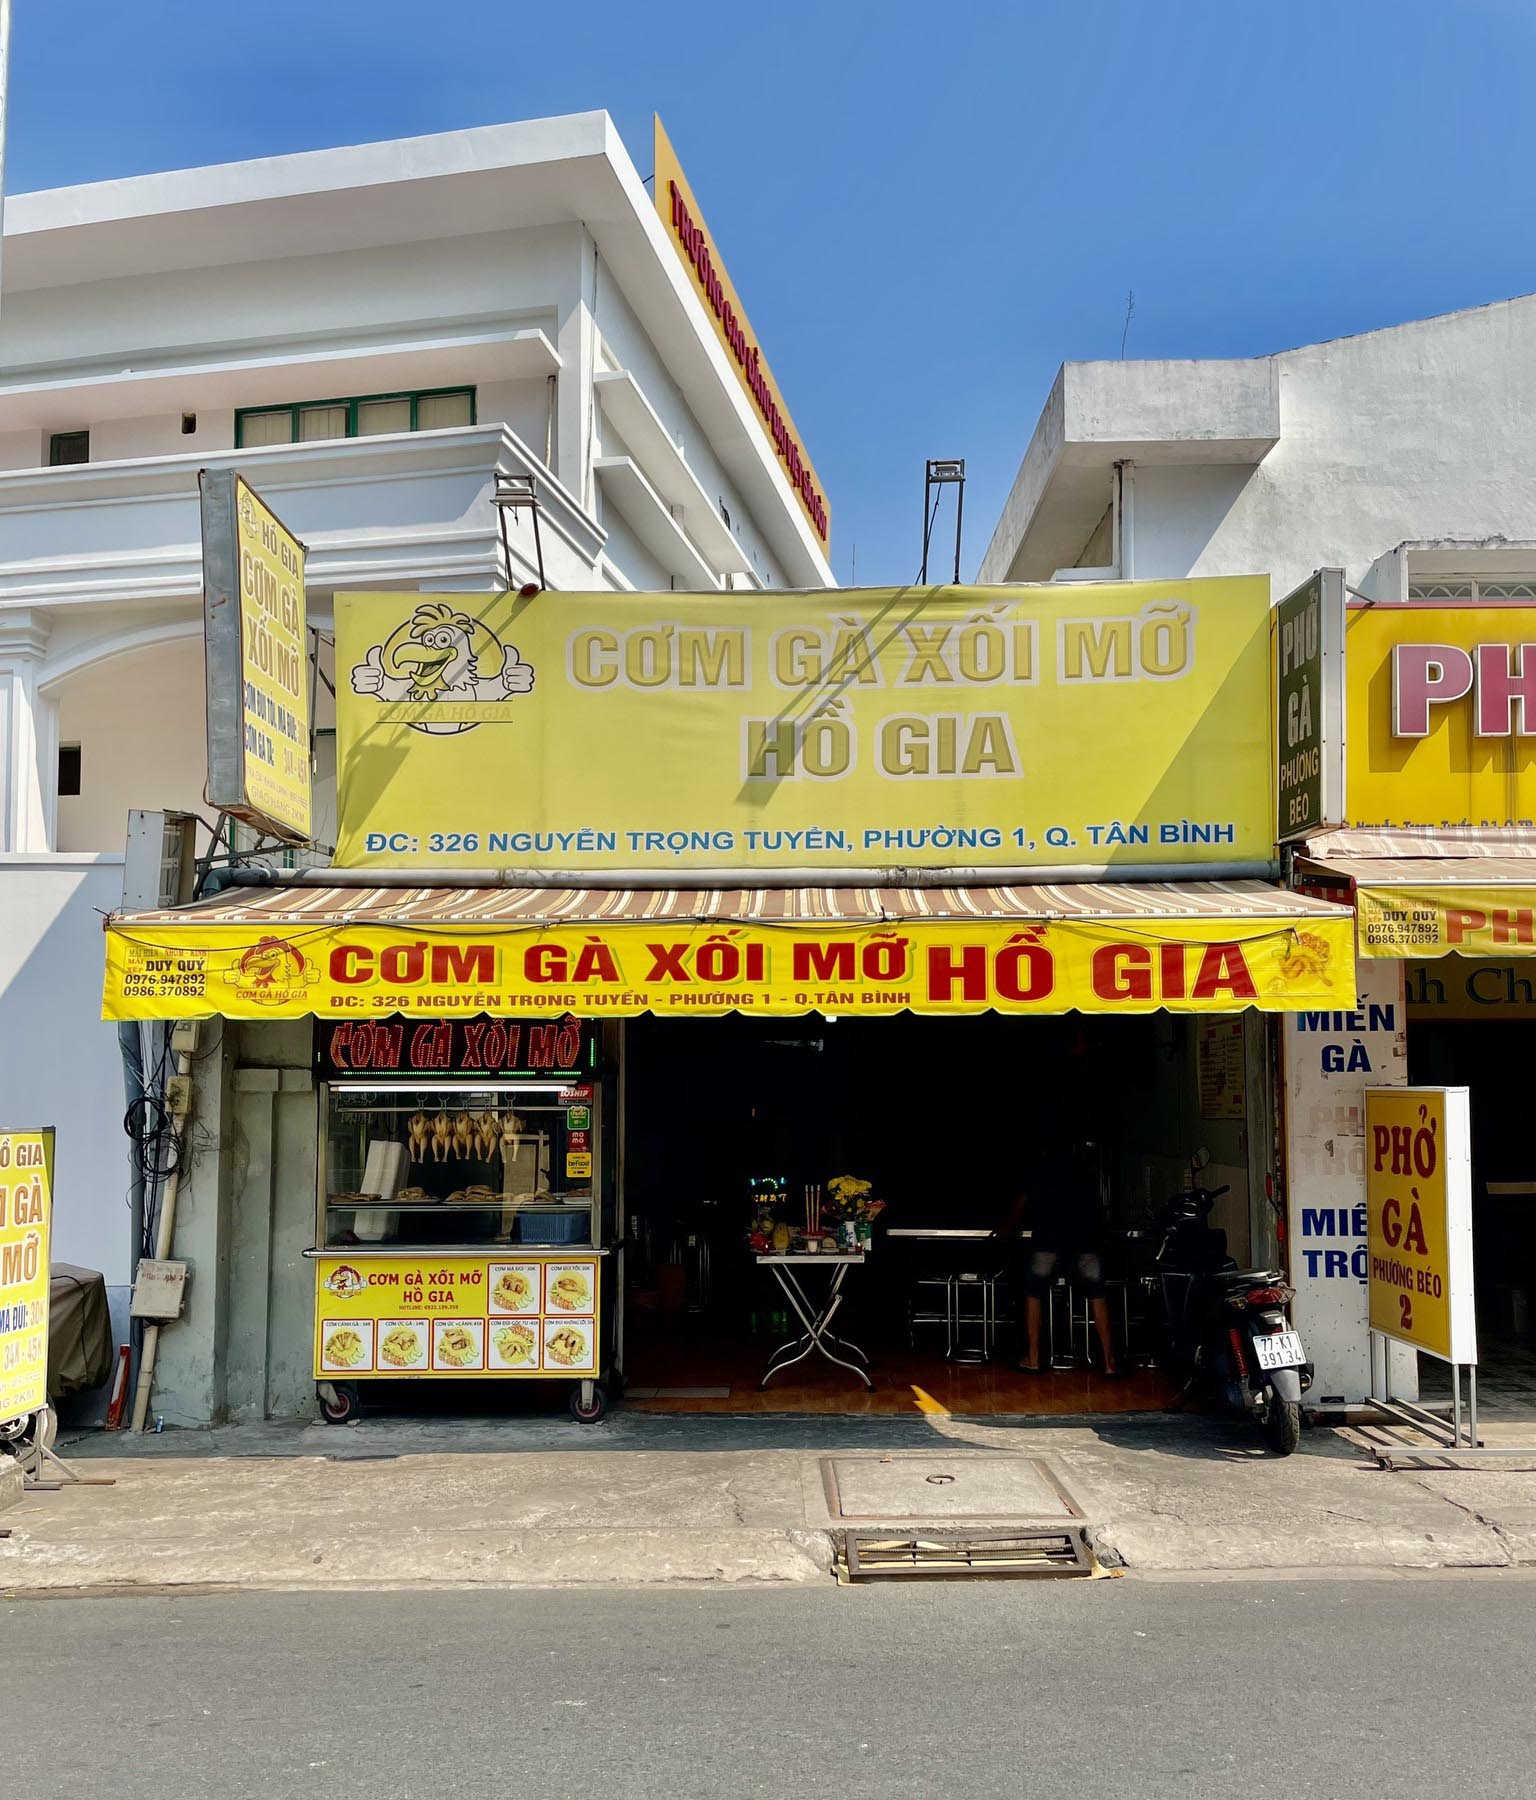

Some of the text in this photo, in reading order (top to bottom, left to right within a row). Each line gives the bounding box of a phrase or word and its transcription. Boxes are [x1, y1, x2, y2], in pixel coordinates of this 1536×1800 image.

[670, 180, 724, 318] TRƯỜNG
[722, 300, 747, 366] CAO
[281, 540, 300, 579] GIA
[243, 549, 301, 640] CƠM GÀ
[572, 605, 1189, 687] CƠM GÀ XỐI MỠ
[1283, 586, 1318, 678] PHỞ
[247, 614, 300, 697] XỐI MỠ
[482, 706, 511, 721] GIA
[1287, 673, 1312, 748] GÀ
[748, 699, 1016, 777] HỒ GIA
[1280, 746, 1318, 791] PHƯƠNG
[1289, 788, 1309, 826] BÉO
[366, 817, 1235, 855] ĐC: 326 NGUYỄN TRỌNG TUYỂN, PHƯỜNG 1, Q. TÂN BÌNH
[1367, 923, 1439, 933] 0976.947892
[1383, 911, 1408, 921] DUY
[1367, 934, 1439, 944] 0986.370892
[125, 973, 206, 985] 0976.947892
[146, 957, 205, 972] DUY QUÝ
[329, 924, 1260, 1003] CƠM GÀ XỐI MỠ HỒ GIA
[124, 986, 205, 996] 0986.370892
[236, 989, 257, 999] CƠM
[291, 990, 308, 999] GIA
[330, 995, 364, 1007] ĐC:
[372, 995, 410, 1007] 326
[416, 991, 501, 1007] NGUYỄN
[508, 994, 576, 1009] TRỌNG
[669, 991, 754, 1005] PHƯỜNG
[762, 993, 770, 1005] 1
[861, 989, 911, 1005] BÌNH
[1296, 993, 1395, 1032] MIẾN
[1321, 1039, 1373, 1073] GÀ
[16, 1143, 43, 1167] GIA
[1373, 1103, 1437, 1179] PHỞ
[14, 1176, 43, 1226] GÀ
[1302, 1202, 1368, 1237] MIÊ
[1381, 1186, 1429, 1256] GÀ
[2, 1231, 39, 1286] MỠ
[368, 1272, 399, 1286] CƠM
[404, 1269, 424, 1286] GÀ
[459, 1269, 483, 1285] MỠ
[1302, 1243, 1368, 1286] TRỘ
[1373, 1256, 1442, 1299] PHƯƠNG BÉO
[428, 1291, 454, 1303] GIA
[1399, 1294, 1413, 1330] 2
[1260, 1335, 1293, 1352] 77-K1
[1261, 1349, 1302, 1367] 391.34
